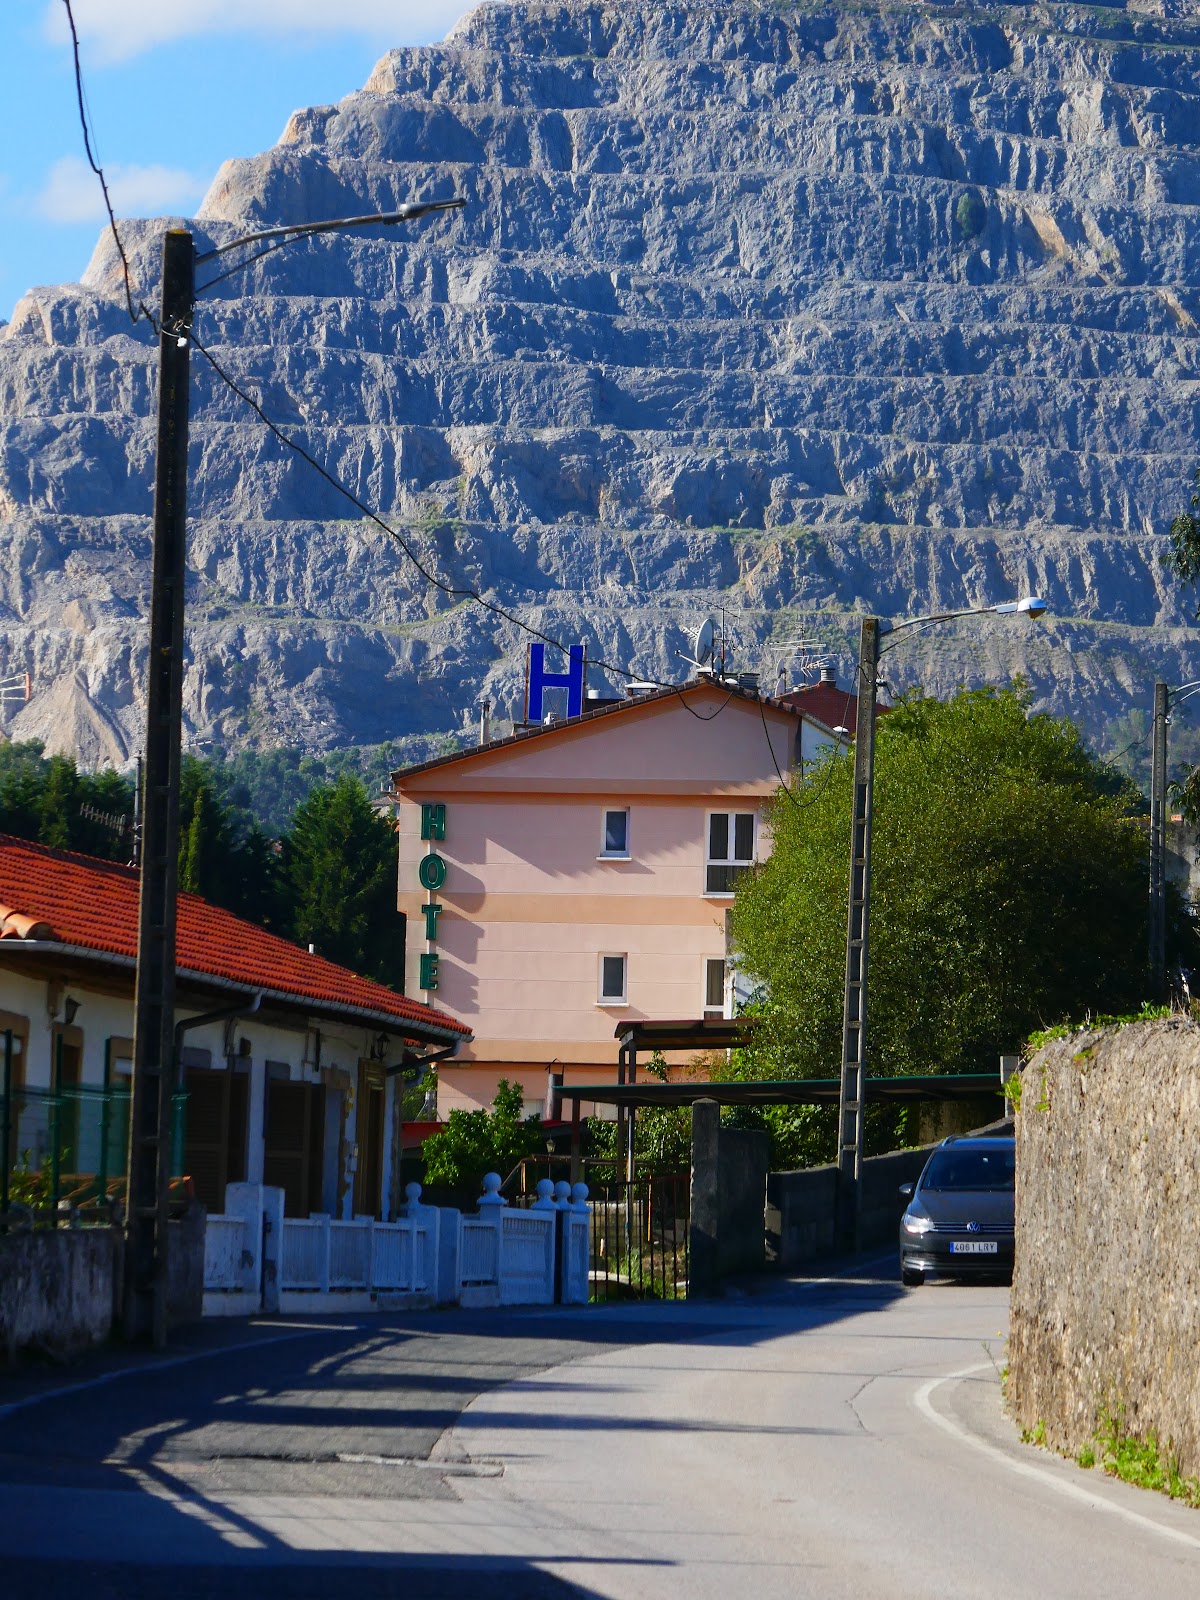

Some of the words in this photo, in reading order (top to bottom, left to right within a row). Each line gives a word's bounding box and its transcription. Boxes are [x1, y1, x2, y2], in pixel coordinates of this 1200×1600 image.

[529, 643, 584, 721] H
[419, 804, 446, 1007] HOTE
[978, 1243, 995, 1252] LRY
